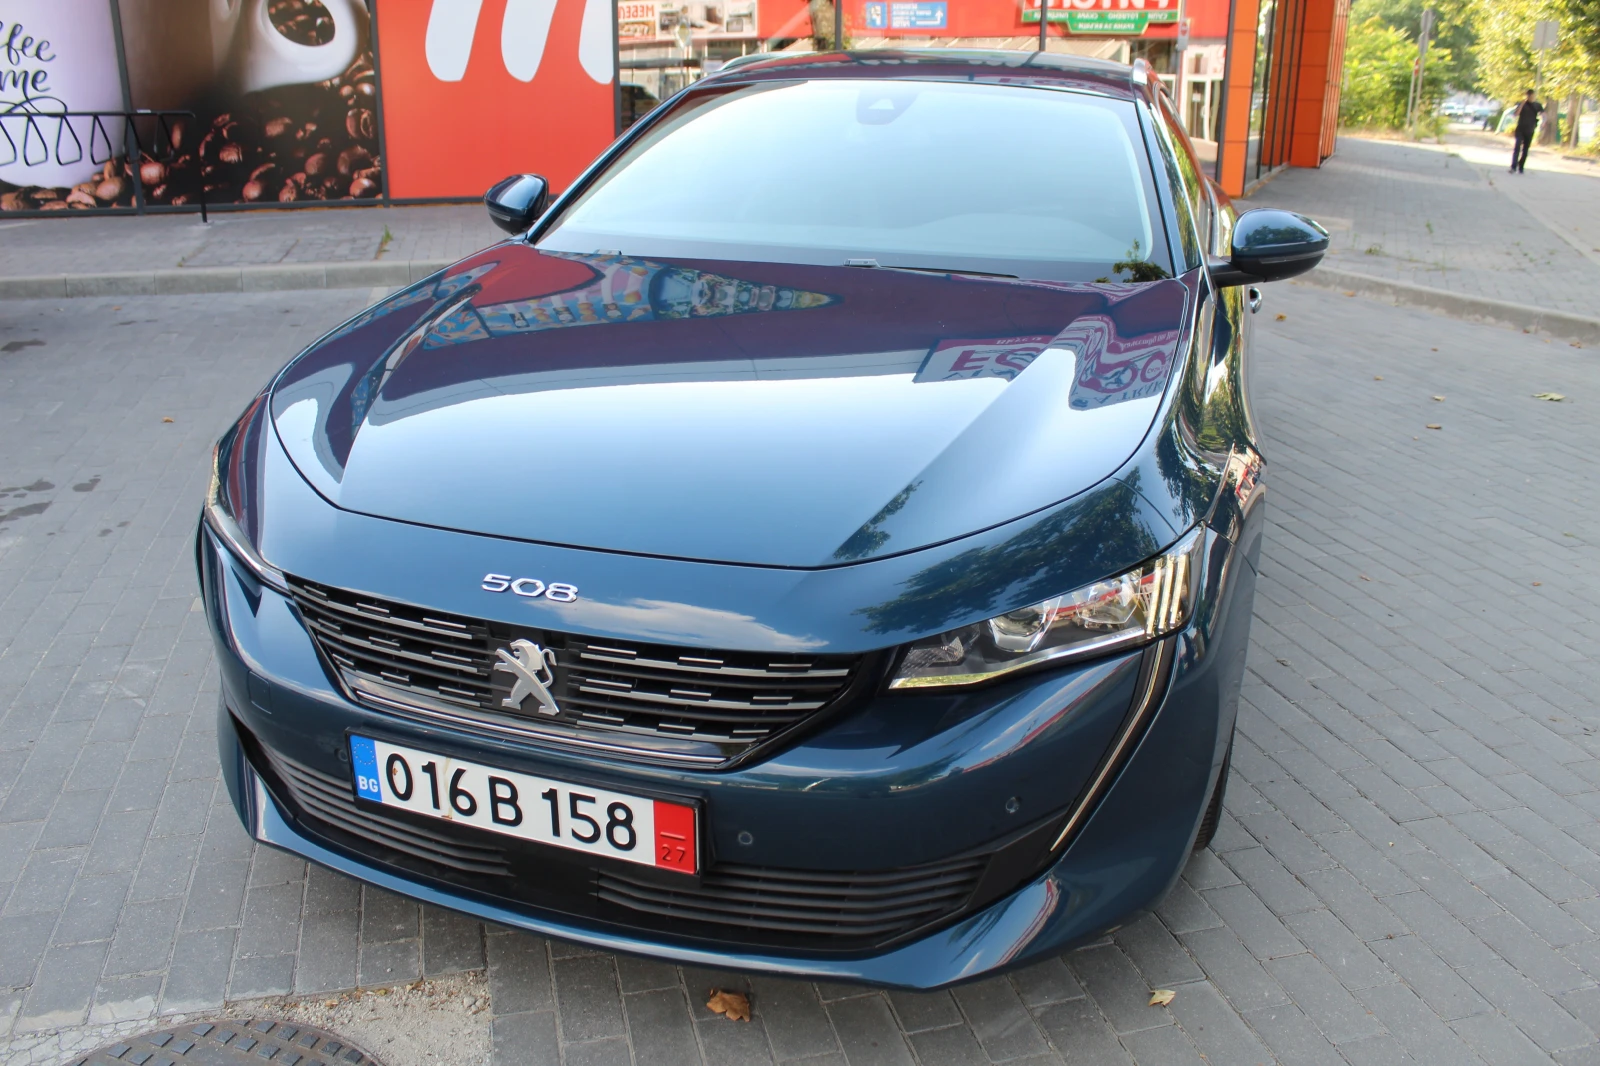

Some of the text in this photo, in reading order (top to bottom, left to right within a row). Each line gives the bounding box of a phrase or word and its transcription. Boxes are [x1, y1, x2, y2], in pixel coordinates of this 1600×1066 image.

[0, 21, 56, 66] fee
[481, 573, 578, 602] 508
[358, 776, 379, 793] BG
[541, 788, 636, 851] 158
[662, 844, 686, 863] 27
